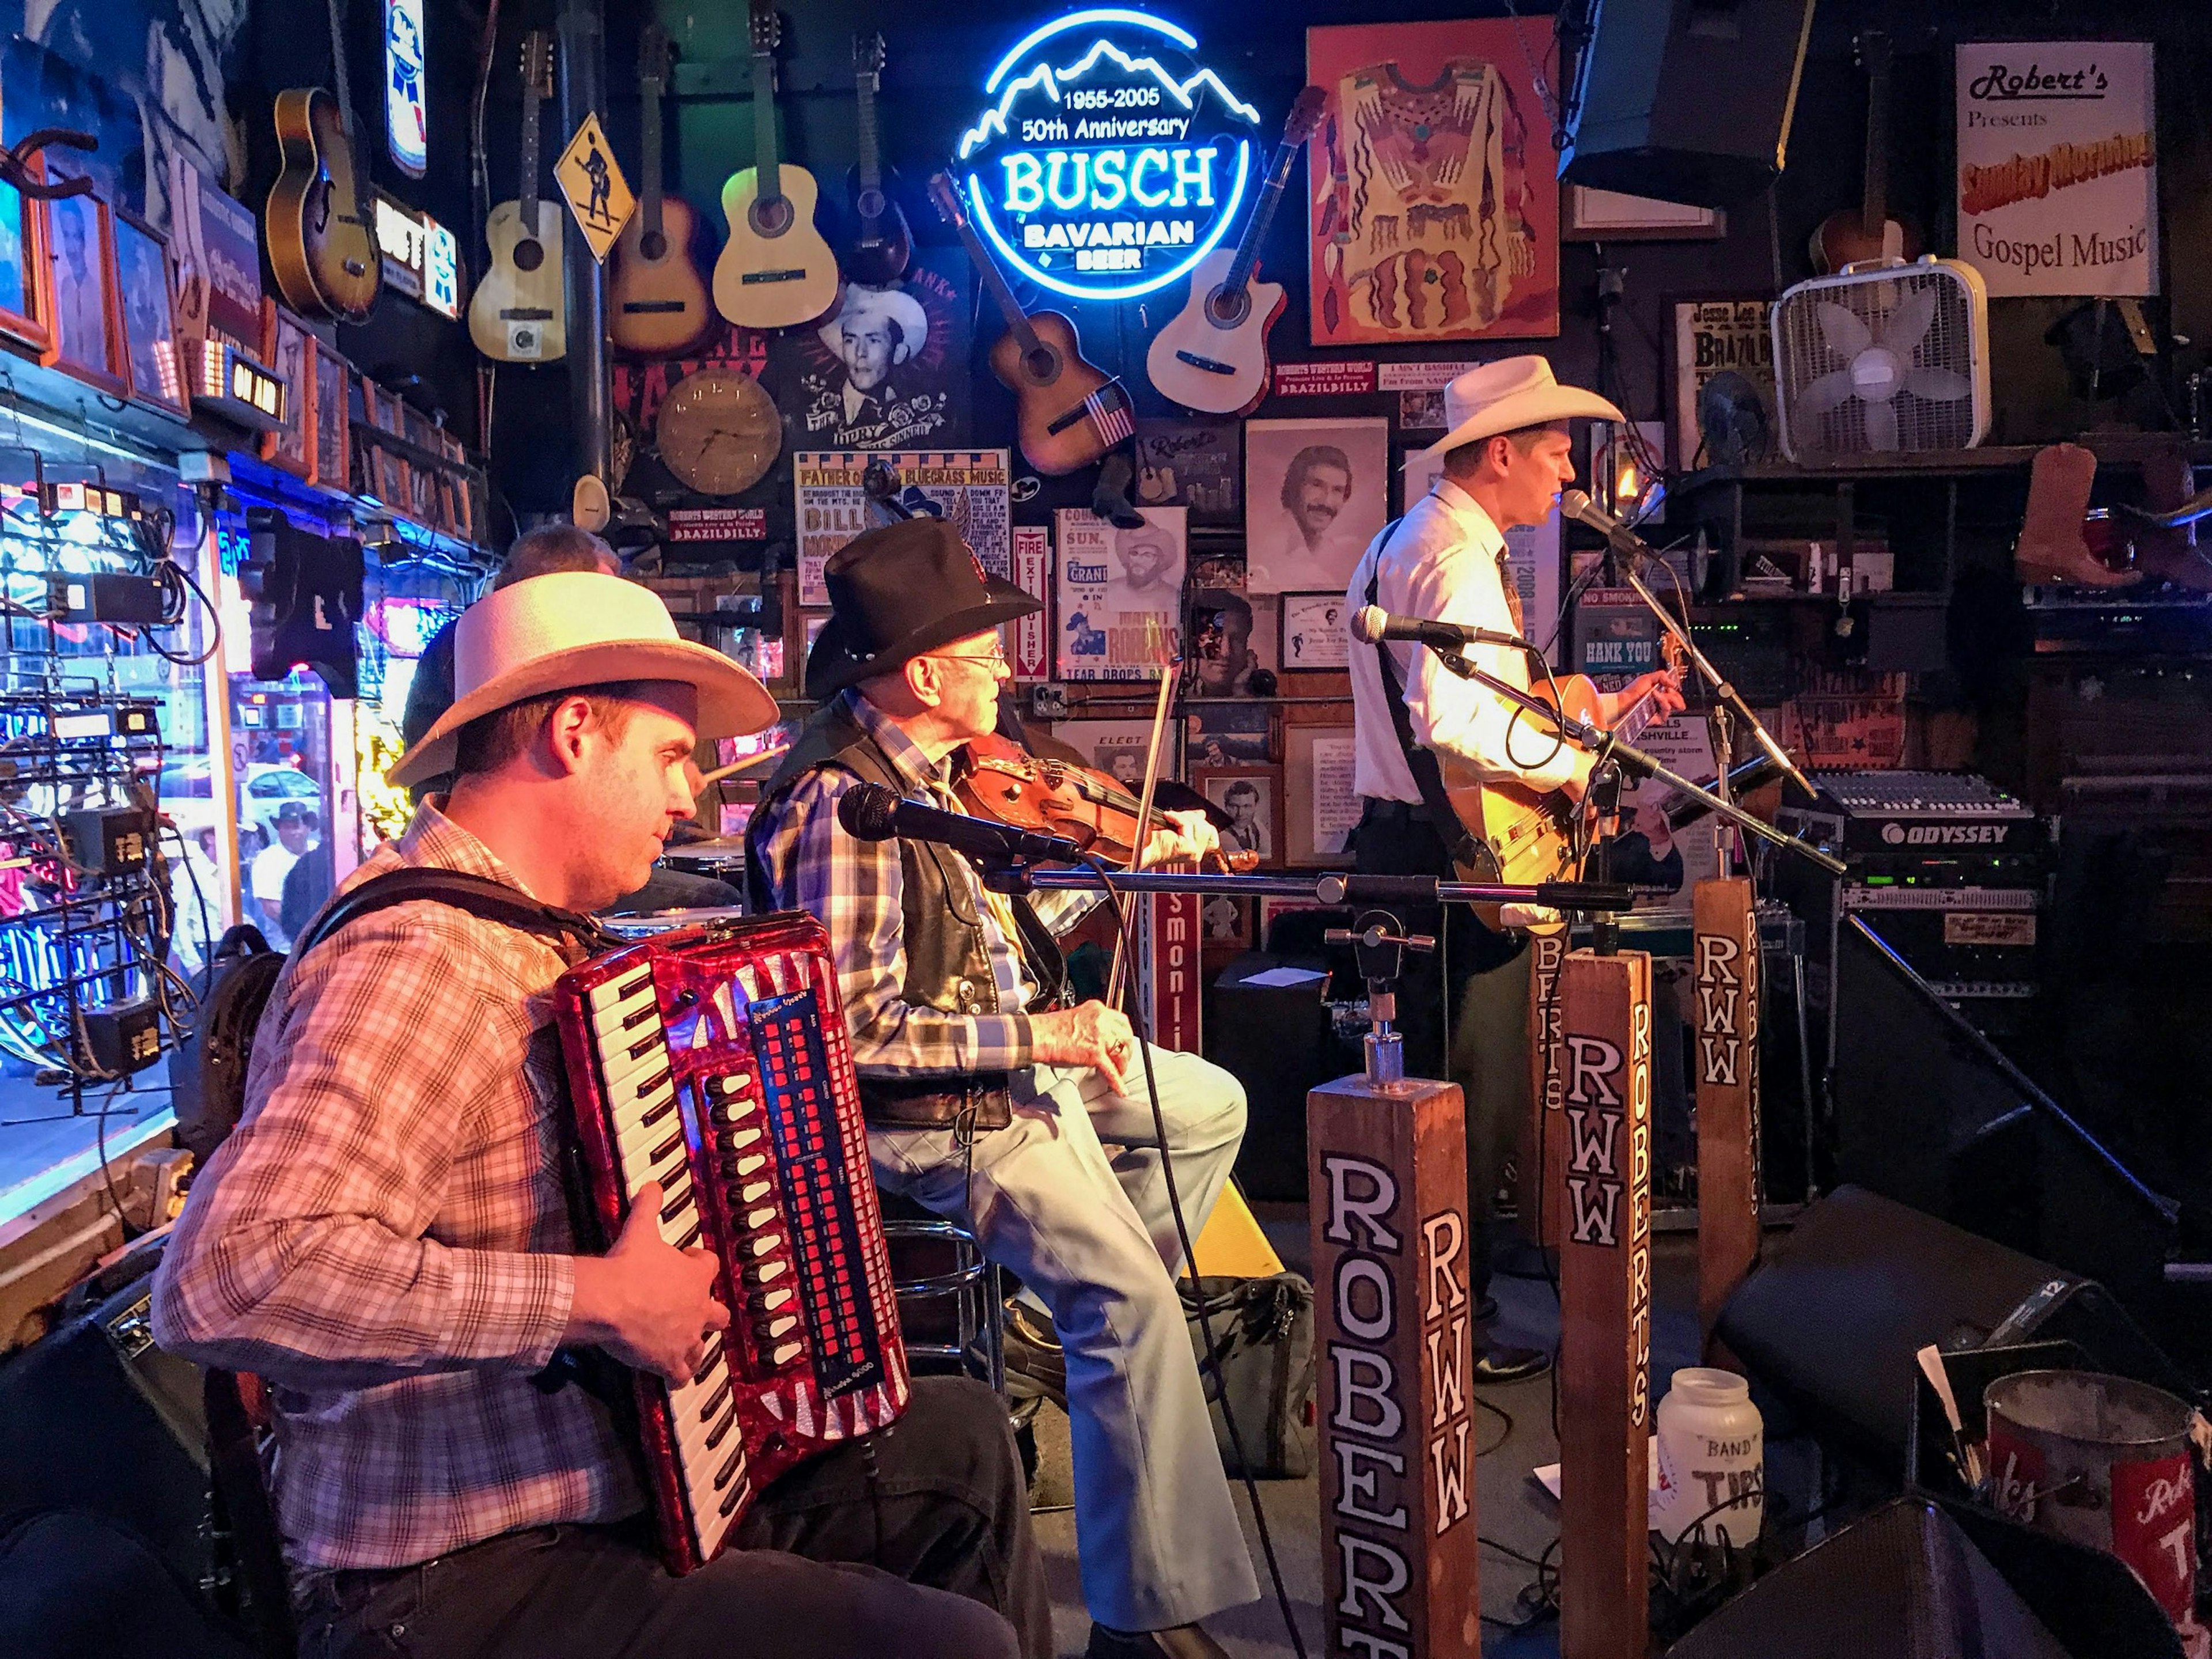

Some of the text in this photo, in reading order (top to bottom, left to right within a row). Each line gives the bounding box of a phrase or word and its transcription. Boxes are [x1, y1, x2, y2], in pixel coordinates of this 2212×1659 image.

[1969, 64, 2108, 99] Robert's
[1064, 88, 1160, 109] 1955-2005
[1022, 117, 1190, 142] 50th Anniversary
[1967, 111, 2048, 128] Presents
[1001, 147, 1218, 213] BUSCH
[1961, 152, 2050, 216] Sunday
[1024, 221, 1194, 248] BAVARIAN
[1075, 248, 1142, 271] BEER
[1974, 224, 2146, 275] Gospel Music
[801, 469, 850, 486] FATHER
[906, 469, 965, 484] BLUEGRASS
[970, 469, 1005, 484] MUSIC
[804, 507, 863, 531] BILL
[1018, 541, 1043, 554] FIRE
[1067, 532, 1104, 544] SUN.
[1584, 593, 1599, 603] NO
[1026, 557, 1036, 667] EXTIUISHER
[1585, 641, 1653, 663] HANK YOU
[1103, 669, 1142, 680] DROPS
[1099, 736, 1142, 744] ELECT
[1907, 825, 2009, 844] ODYSSEY
[1699, 936, 1740, 1084] RWW
[1566, 1036, 1621, 1245] RWW
[1633, 1004, 1650, 1427] ROBERT'S
[1423, 1212, 1471, 1535] RWW
[1691, 1463, 1762, 1512] TIPS
